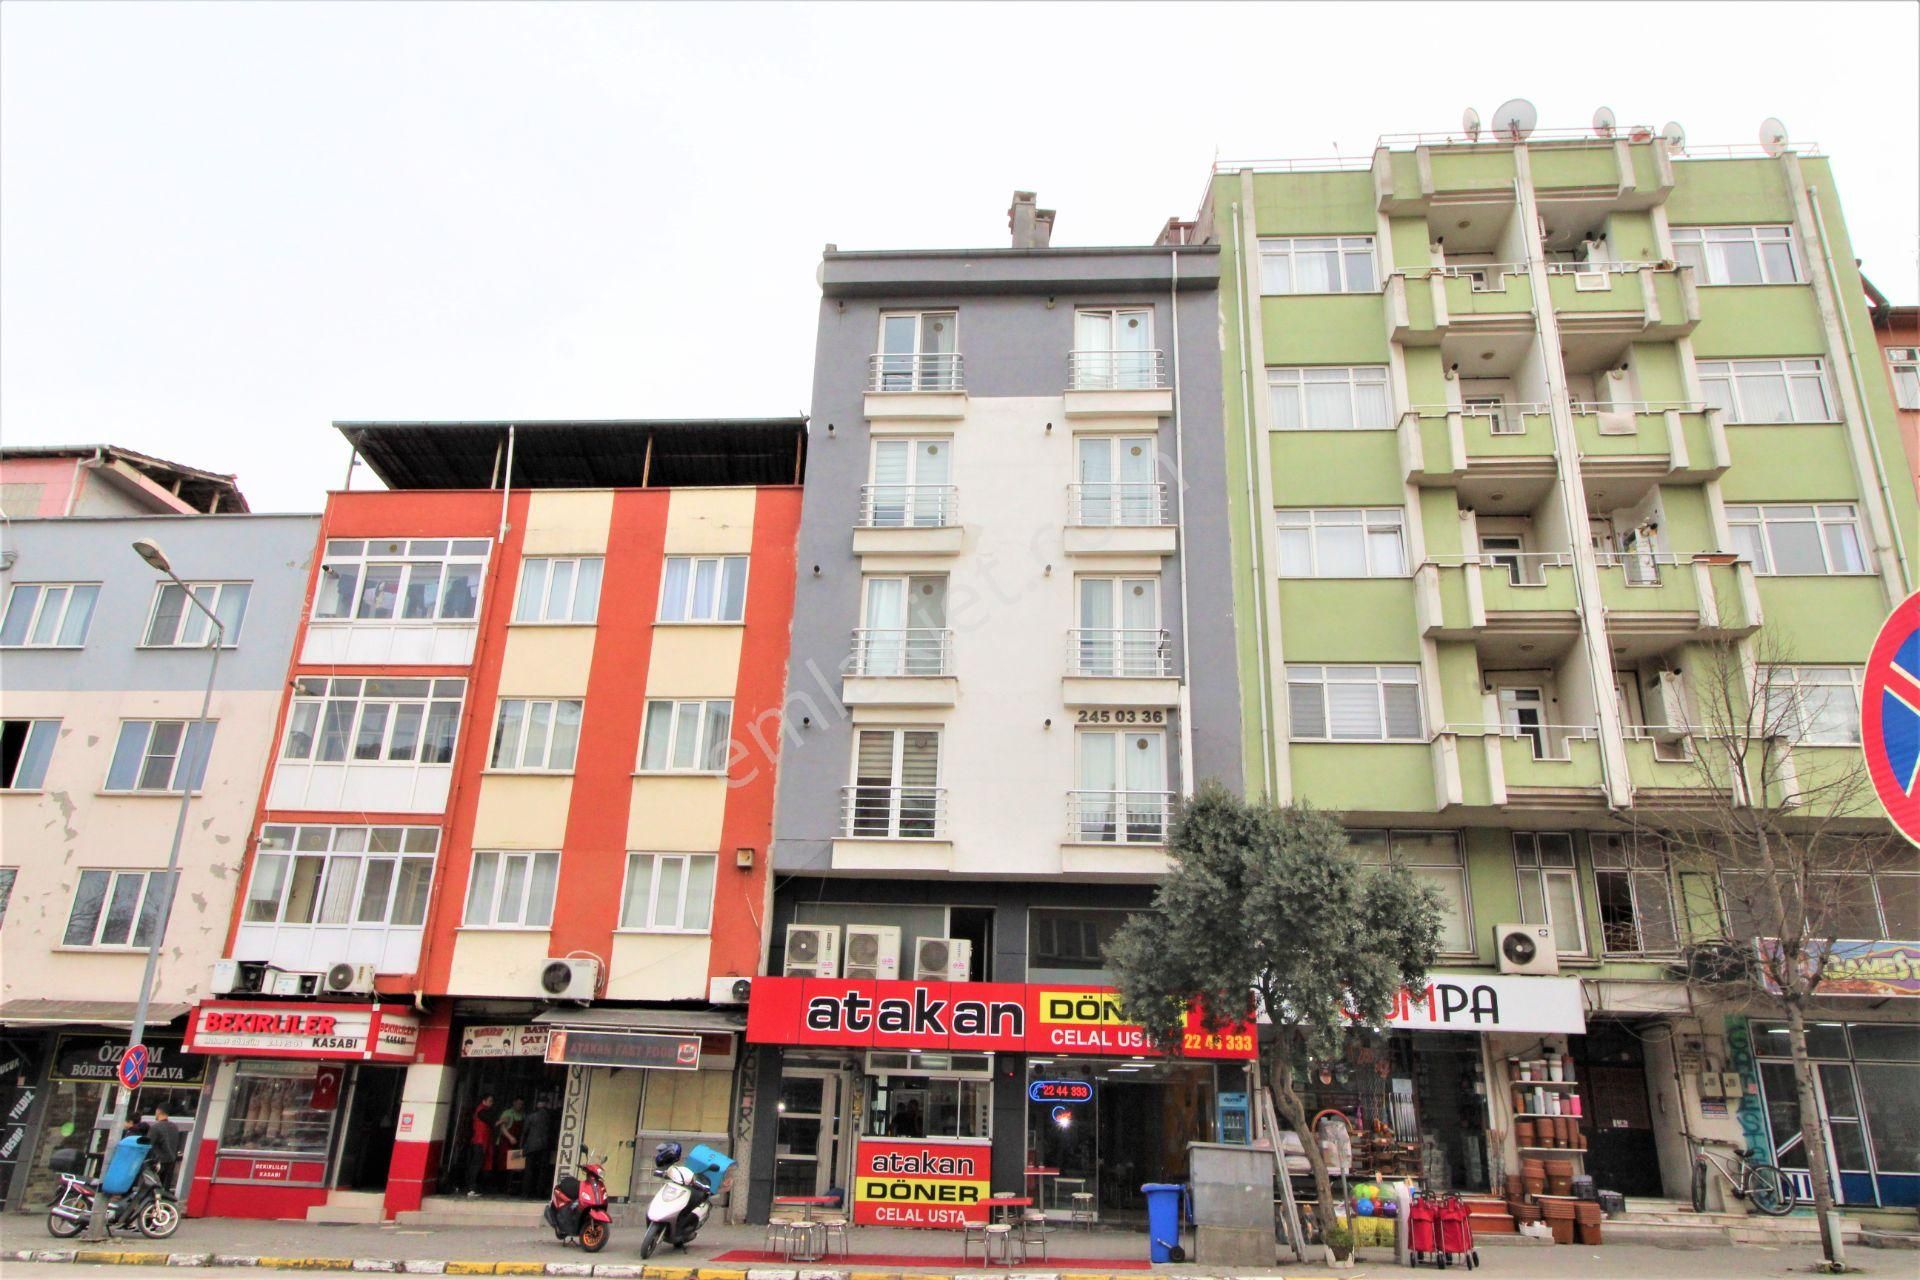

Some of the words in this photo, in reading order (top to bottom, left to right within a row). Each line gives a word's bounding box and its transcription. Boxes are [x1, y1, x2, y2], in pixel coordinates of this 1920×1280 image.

[1078, 710, 1110, 723] 245
[1115, 710, 1136, 723] 03
[1142, 710, 1163, 723] 36
[807, 987, 1024, 1037] atakan
[1050, 995, 1134, 1021] DÖN
[1051, 1029, 1112, 1046] CELAL
[1117, 1032, 1158, 1048] US
[1184, 1034, 1201, 1049] 22
[1226, 1035, 1252, 1051] 333
[98, 1041, 163, 1063] ÖZM
[71, 1061, 113, 1078] BÖREK
[1043, 1085, 1055, 1096] 22
[1056, 1085, 1068, 1097] 44
[1070, 1086, 1088, 1097] 333
[872, 1150, 974, 1176] atakan
[866, 1179, 979, 1203] DÖNER
[875, 1207, 924, 1222] CELAL
[928, 1210, 966, 1223] USTA
